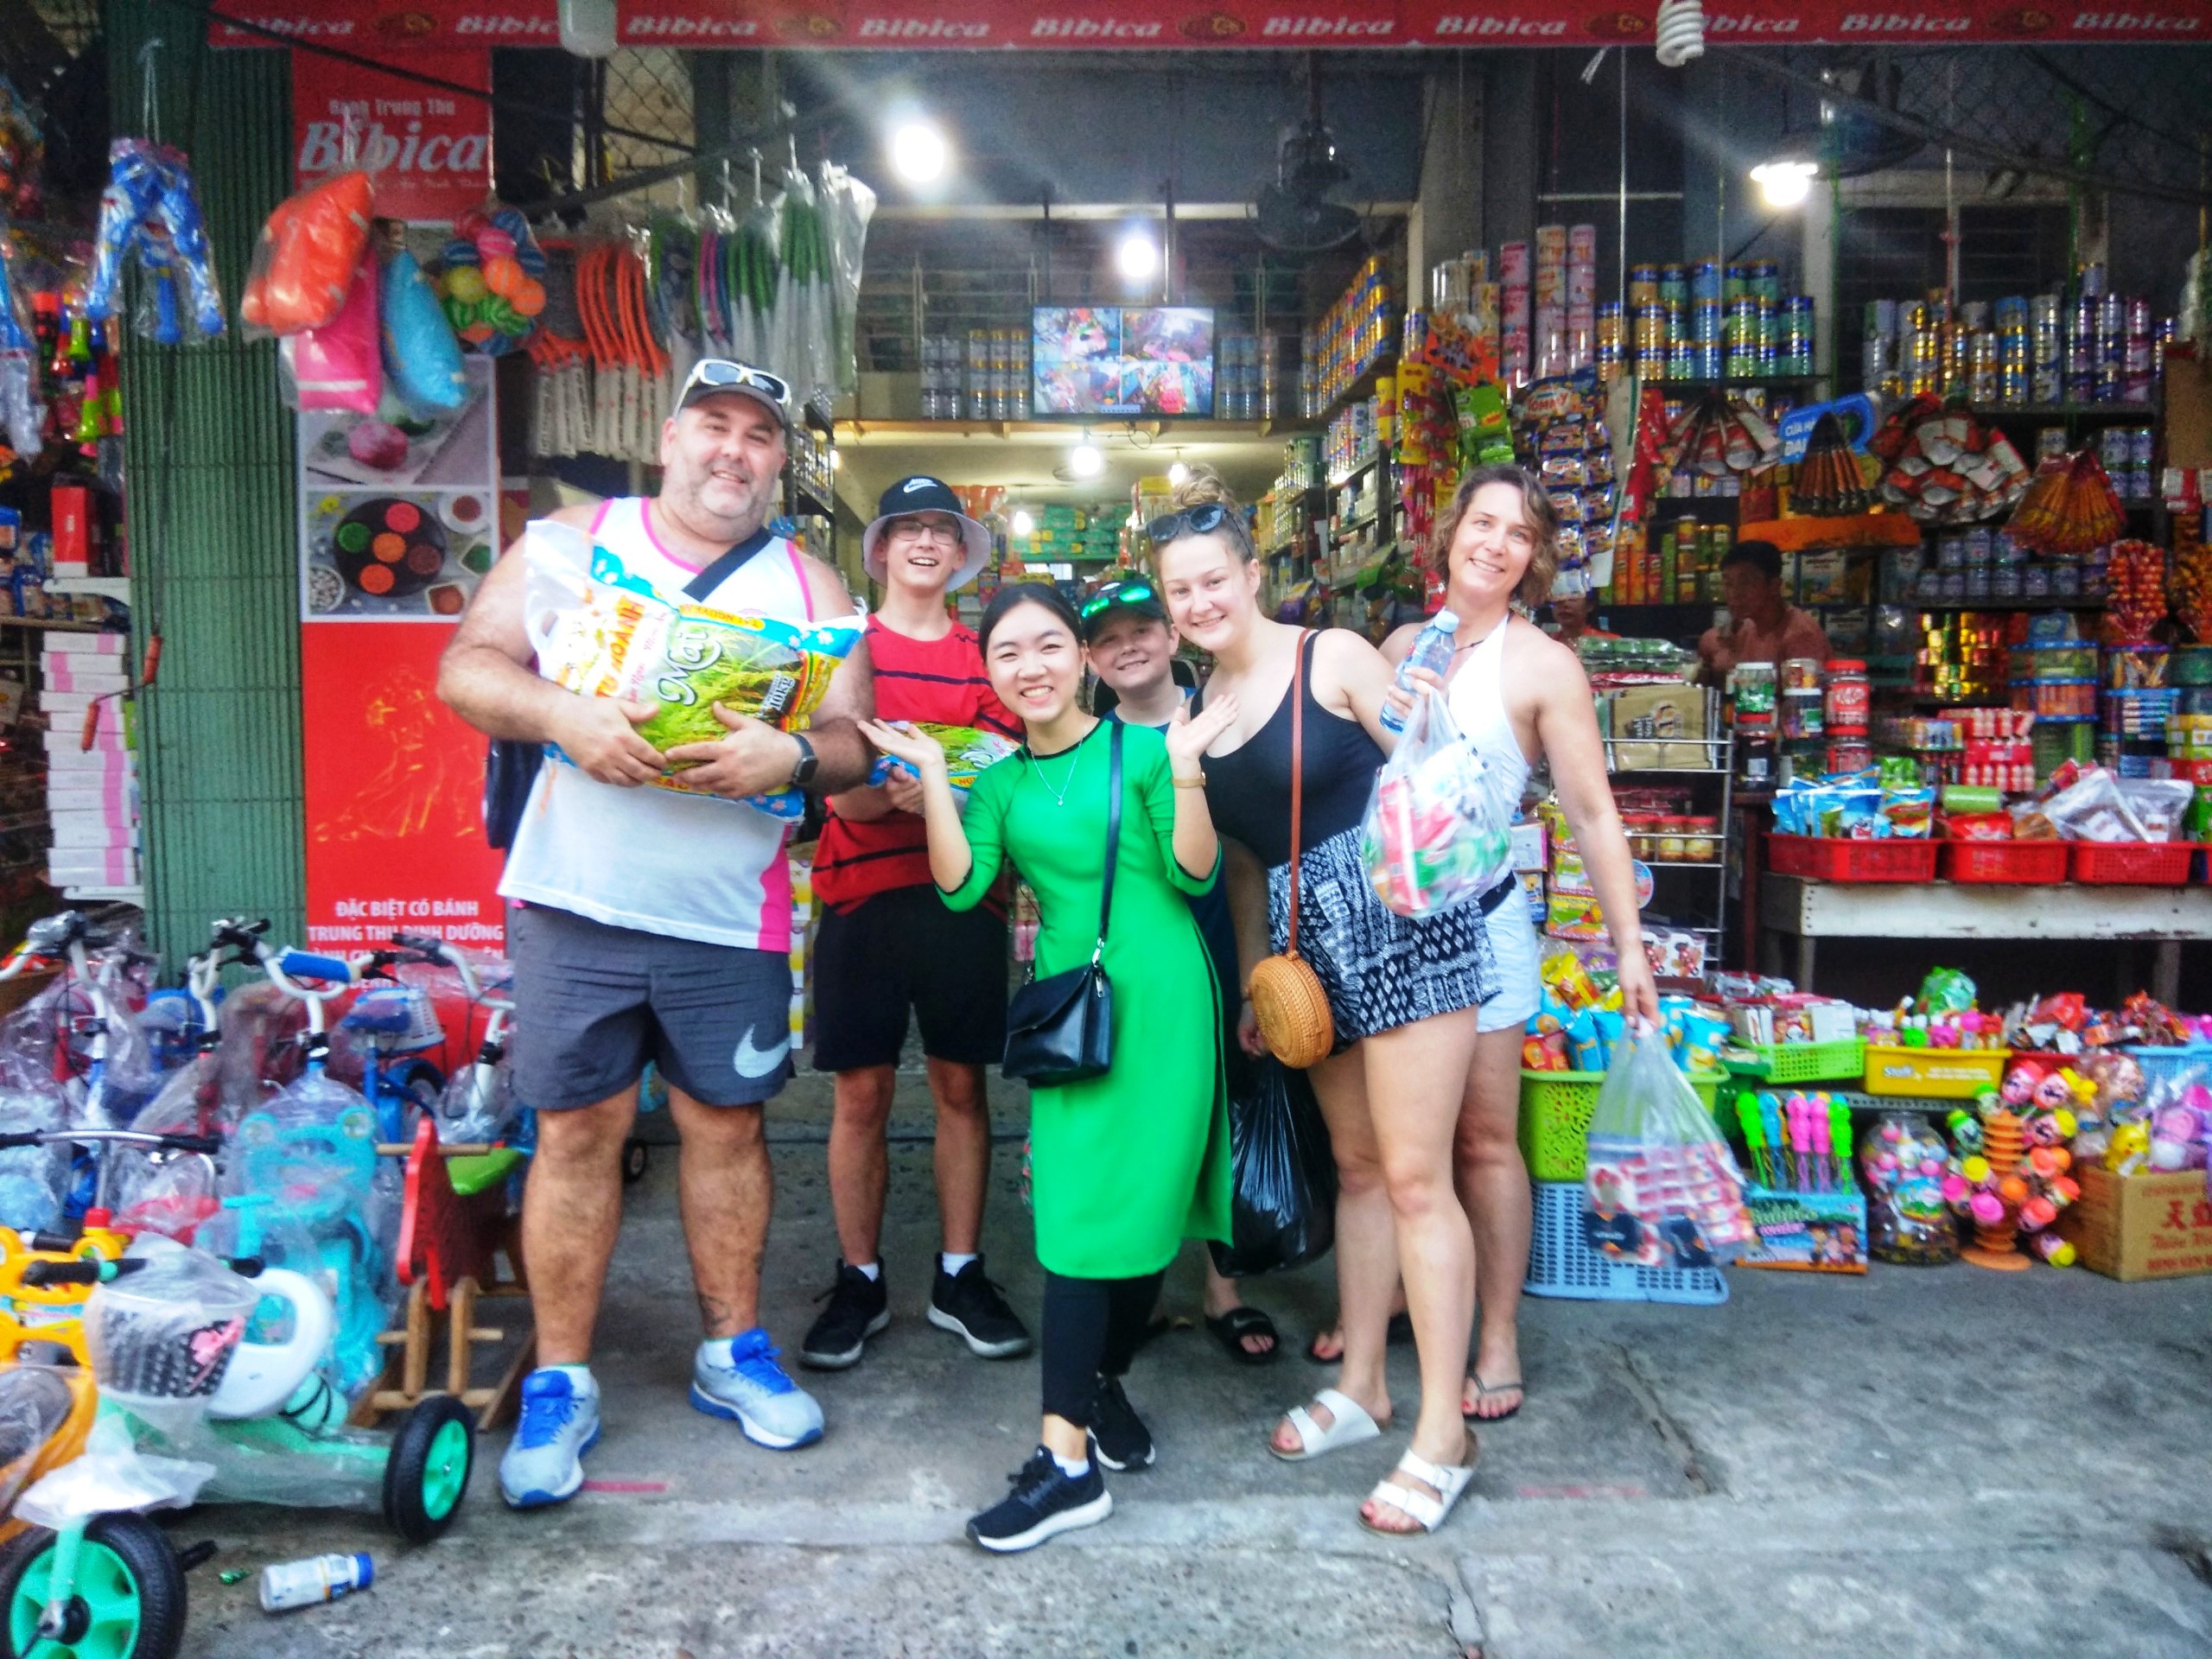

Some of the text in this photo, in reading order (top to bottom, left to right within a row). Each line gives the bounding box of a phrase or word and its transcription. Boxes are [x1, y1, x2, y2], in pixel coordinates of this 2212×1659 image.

[455, 16, 558, 35] Bibic
[626, 16, 758, 36] Bibica
[860, 17, 990, 37] Bibica
[1030, 17, 1163, 37] Bibica
[1262, 16, 1396, 36] Bibica
[1435, 16, 1567, 36] Bibica
[1840, 13, 1973, 32] Bibica
[2073, 12, 2201, 31] Bibica
[768, 673, 797, 710] 10kg
[335, 897, 480, 921] ĐẶC BIỆT CÓ BÁNH
[308, 925, 364, 942] TRUNG
